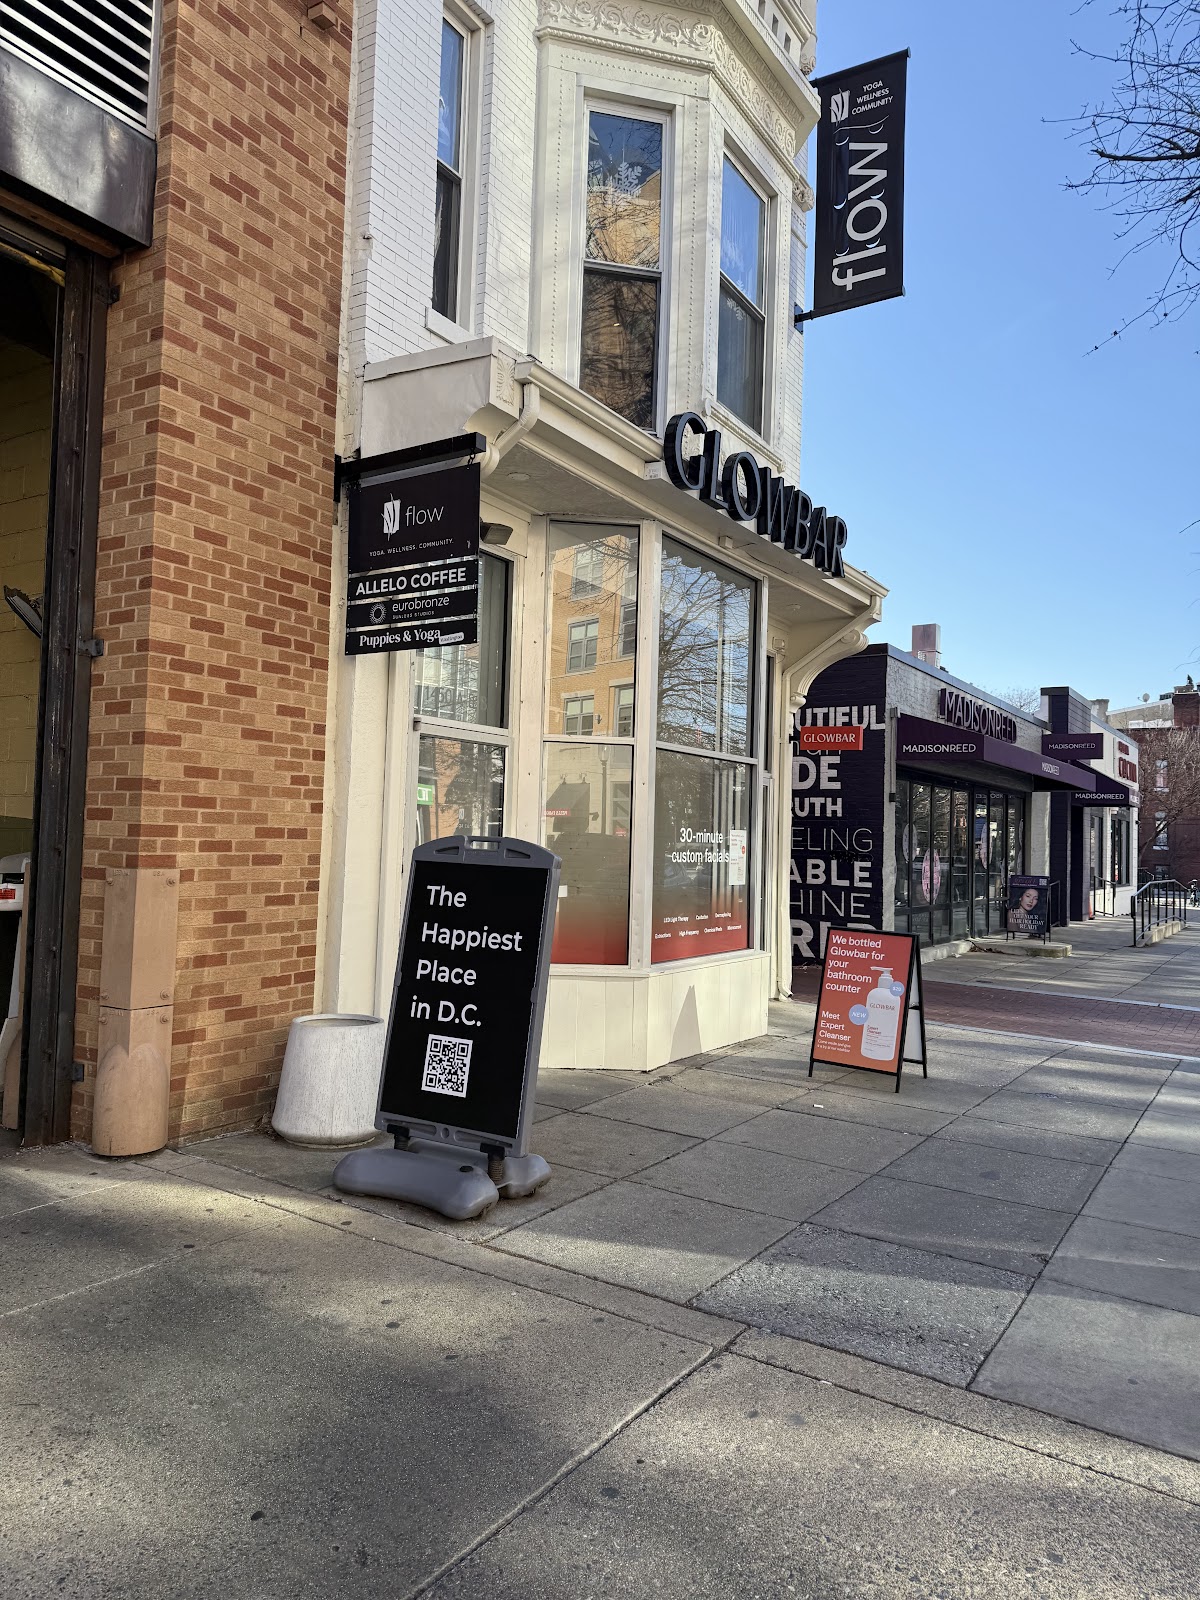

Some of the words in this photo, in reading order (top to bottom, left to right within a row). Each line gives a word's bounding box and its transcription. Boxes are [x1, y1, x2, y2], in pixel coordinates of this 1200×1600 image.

[863, 80, 883, 92] YOGA
[856, 88, 889, 104] WELLNESS
[851, 96, 893, 115] COMMUNITY
[831, 142, 888, 291] flow
[664, 411, 848, 578] GLOWBAR
[405, 506, 444, 527] flow
[419, 538, 454, 549] COMMUNITY.
[355, 576, 407, 596] ALLELO
[410, 567, 467, 588] COFFEE
[392, 596, 450, 612] eurobronze
[359, 631, 401, 648] Puppies
[402, 630, 411, 642] &
[414, 628, 441, 643] Yoga
[939, 688, 1017, 744] MADISONREED
[803, 733, 856, 743] GLOWBAR
[902, 743, 977, 753] MADISONREED
[791, 797, 843, 817] UTH
[679, 827, 724, 844] 30-minute
[671, 849, 702, 863] custom
[704, 848, 730, 863] facials
[426, 885, 467, 908] The
[421, 922, 523, 952] Happiest
[831, 934, 847, 945] We
[848, 936, 882, 949] bottled
[830, 946, 870, 959] Glowbar
[871, 950, 885, 961] for
[827, 959, 849, 969] your
[415, 959, 477, 986] Place
[826, 969, 872, 984] bathroom
[825, 982, 861, 994] counter
[410, 995, 431, 1020] in
[437, 1000, 482, 1027] D.C.
[869, 1002, 896, 1011] GLOWBAR
[821, 1010, 840, 1021] Meet
[851, 1011, 867, 1019] NEW
[820, 1020, 845, 1031] Expert
[819, 1029, 851, 1042] Cleanser
